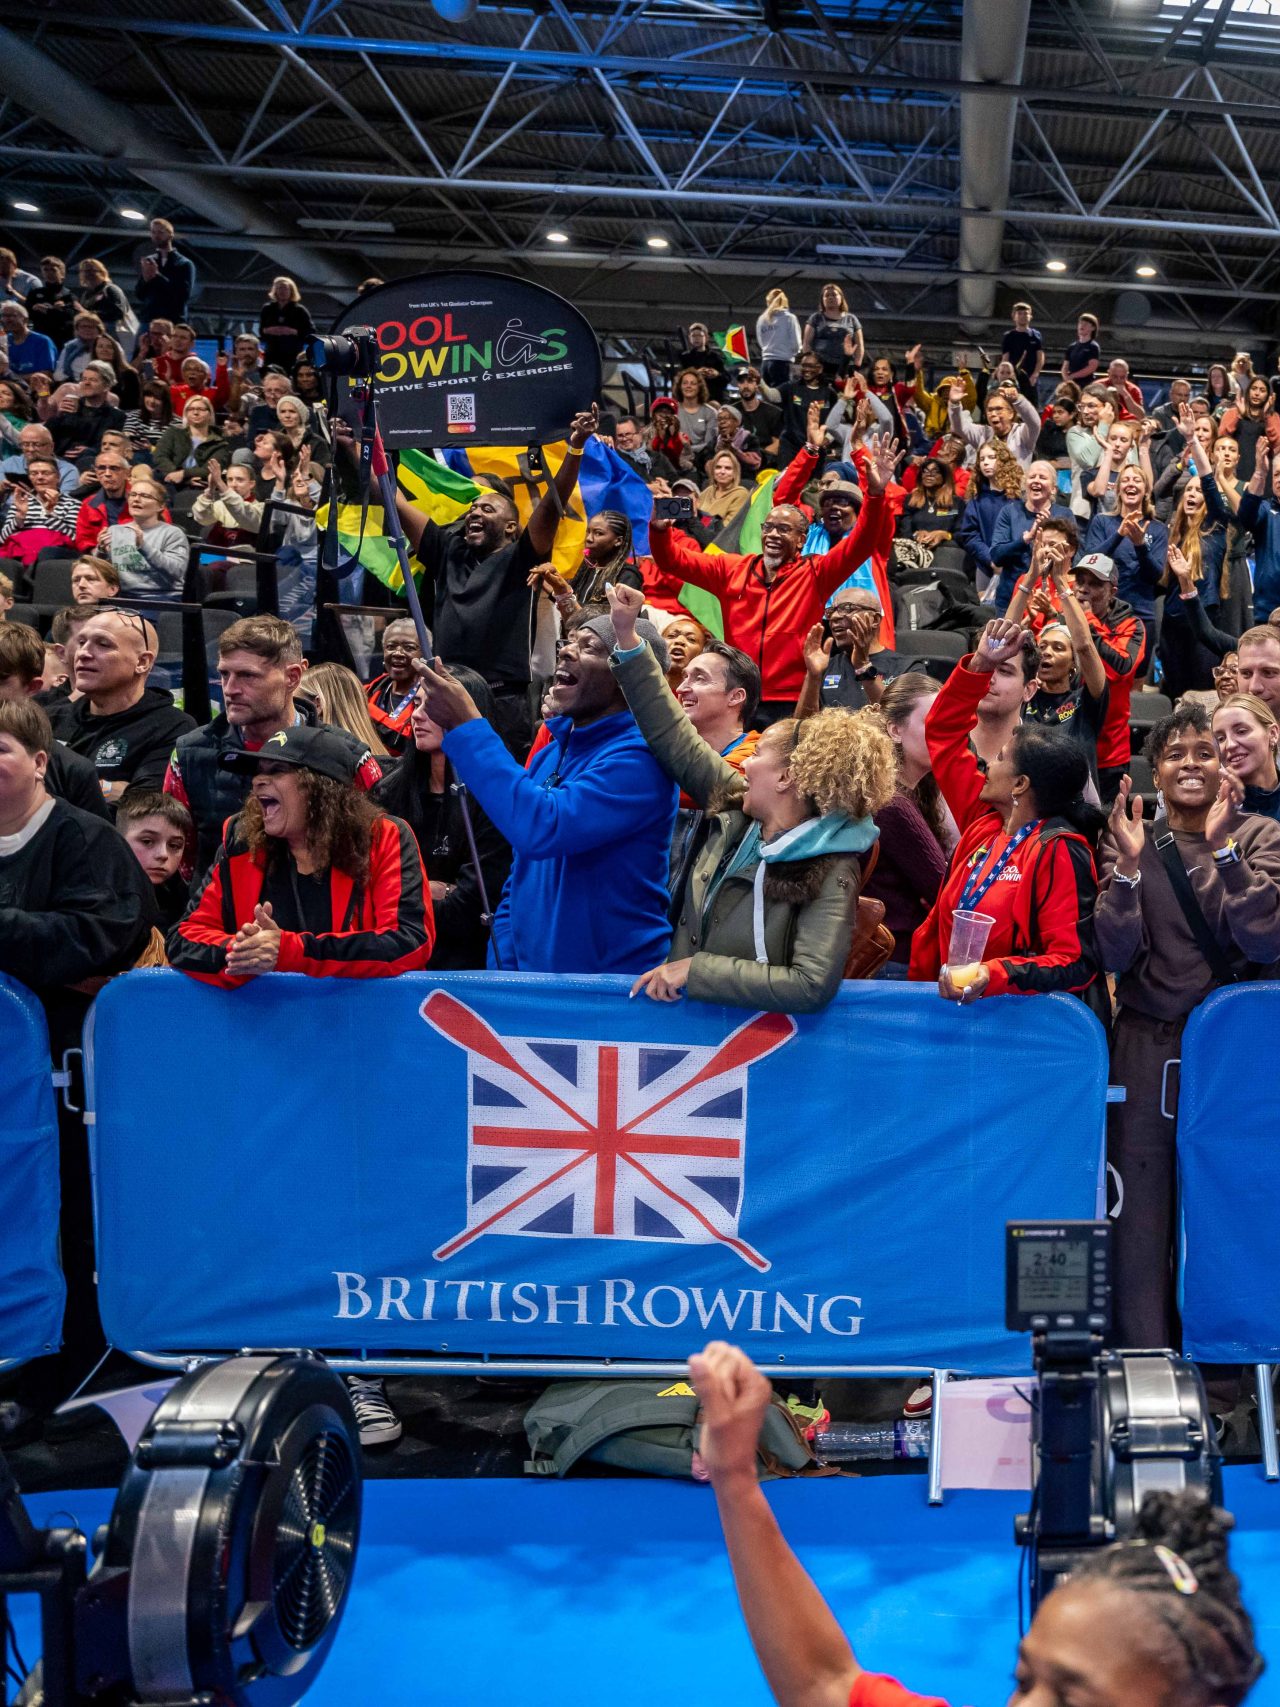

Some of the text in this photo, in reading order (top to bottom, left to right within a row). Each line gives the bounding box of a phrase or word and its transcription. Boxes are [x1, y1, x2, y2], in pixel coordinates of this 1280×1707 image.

[374, 313, 468, 350] OOL
[427, 375, 479, 389] SPORT
[495, 362, 574, 380] EXERCISE
[1000, 865, 1020, 874] OOL
